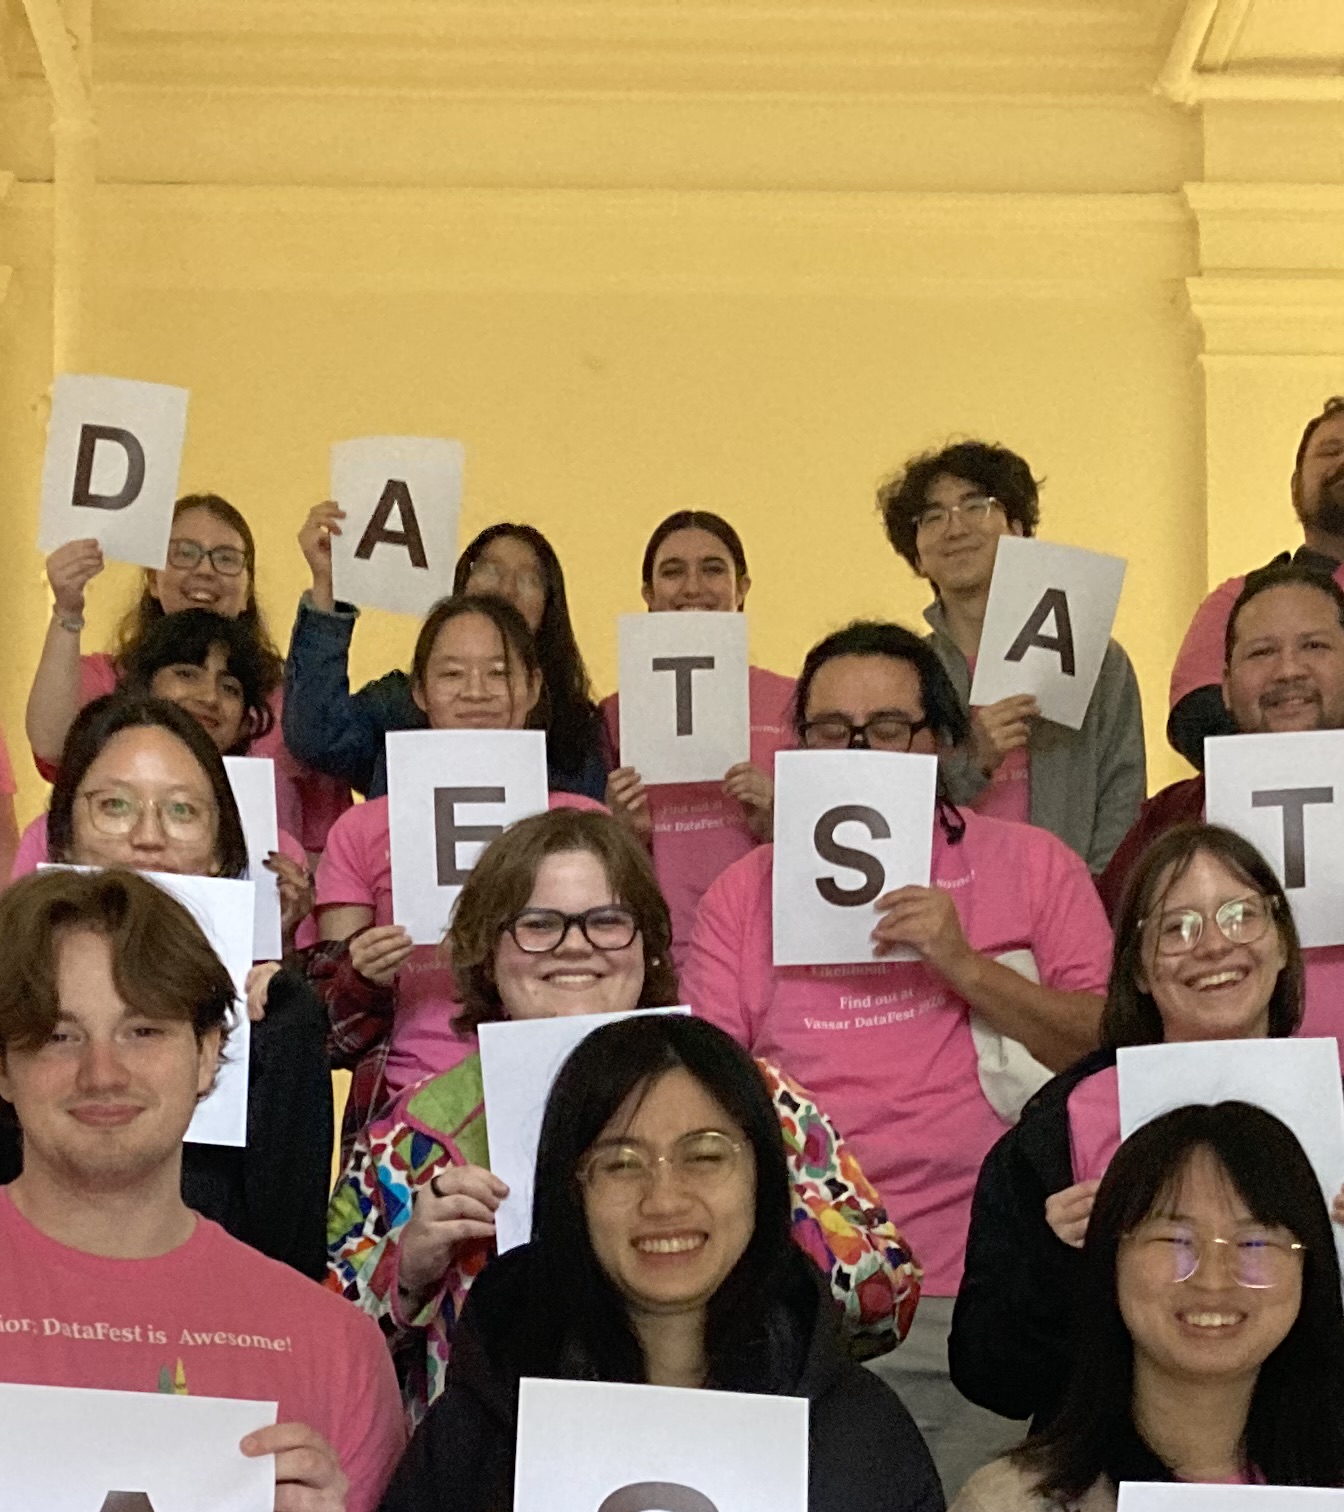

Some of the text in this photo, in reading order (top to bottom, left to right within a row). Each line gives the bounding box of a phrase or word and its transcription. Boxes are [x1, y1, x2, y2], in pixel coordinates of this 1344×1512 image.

[72, 424, 146, 511] D
[353, 479, 429, 570] A
[1003, 588, 1076, 678] A
[652, 656, 715, 737] T
[434, 787, 506, 886] E
[813, 804, 892, 907] S
[1252, 787, 1334, 889] T
[804, 1016, 851, 1030] Vassar
[855, 1006, 916, 1029] DataFest
[840, 996, 872, 1010] Find
[875, 993, 898, 1006] out
[42, 1318, 143, 1343] DataFest
[147, 1324, 167, 1345] is
[179, 1328, 293, 1352] Awesome!
